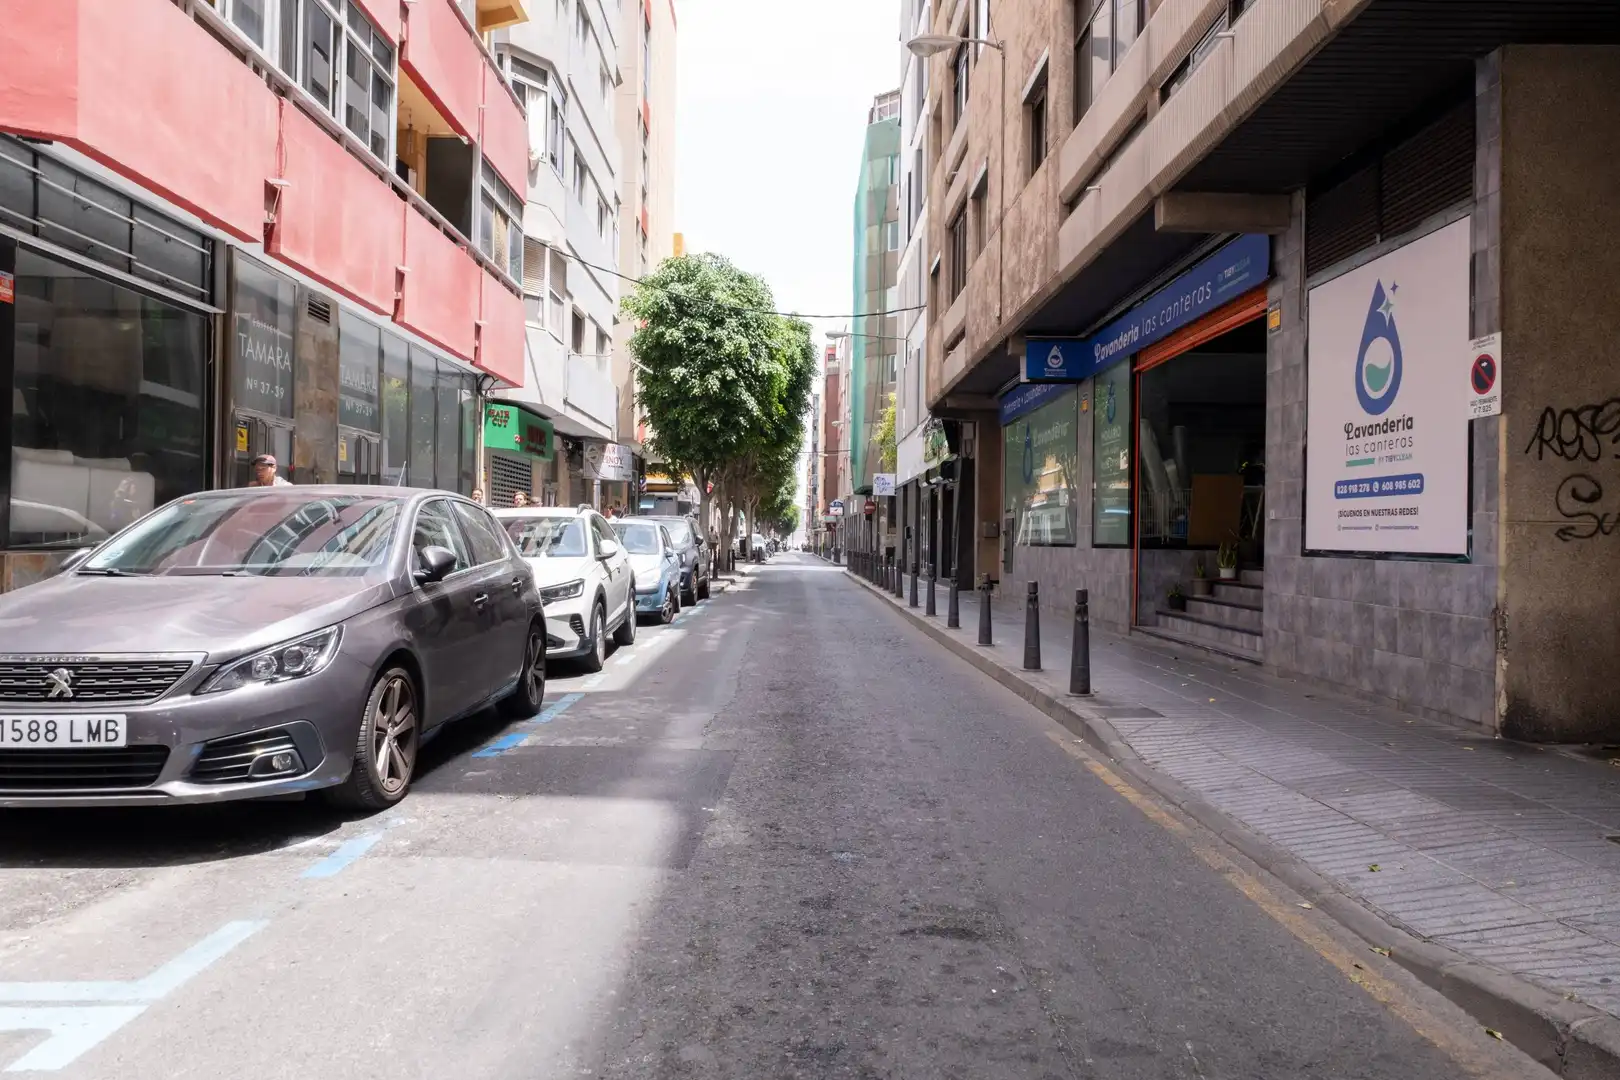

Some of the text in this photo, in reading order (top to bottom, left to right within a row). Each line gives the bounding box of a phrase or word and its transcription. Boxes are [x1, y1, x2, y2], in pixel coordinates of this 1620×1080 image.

[1141, 314, 1157, 337] las
[1159, 281, 1212, 328] canteras
[238, 332, 292, 373] TAMARA
[1344, 414, 1413, 440] Lavandería
[1345, 436, 1414, 457] las canteras
[1336, 479, 1421, 494] 828 918 278 608 985 602
[1363, 509, 1371, 517] EN
[1371, 507, 1398, 517] NUESTRAS
[1398, 506, 1419, 516] REDES!
[0, 719, 120, 743] 1588 LMB
